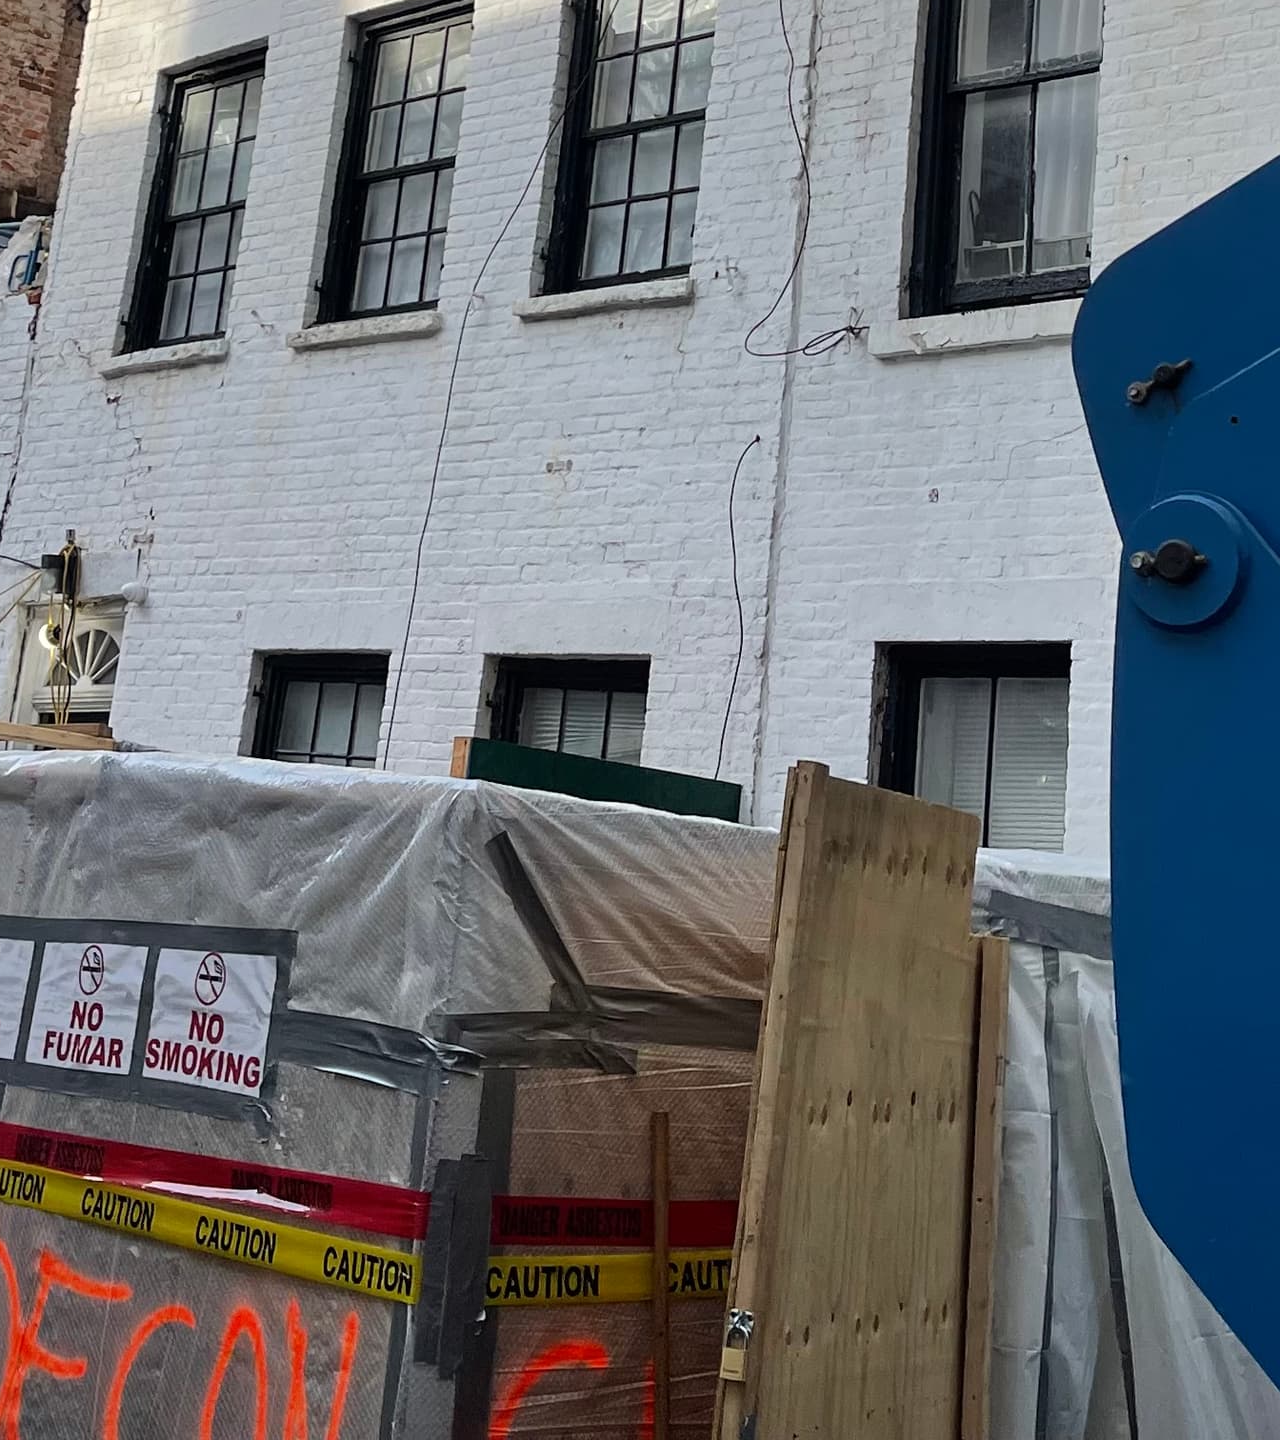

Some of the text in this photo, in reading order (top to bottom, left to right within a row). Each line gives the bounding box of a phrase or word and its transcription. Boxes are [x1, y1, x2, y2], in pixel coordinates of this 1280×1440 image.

[70, 1000, 104, 1032] NO
[188, 1010, 223, 1044] NO
[42, 1030, 124, 1069] FUMAR
[144, 1038, 261, 1088] SMOKING
[500, 1205, 641, 1239] DANGER ASBESTOS
[81, 1187, 156, 1232] CAUTION
[195, 1215, 277, 1264] CAUTION
[323, 1246, 413, 1297] CAUTION
[486, 1259, 732, 1299] CAUTION CAUT
